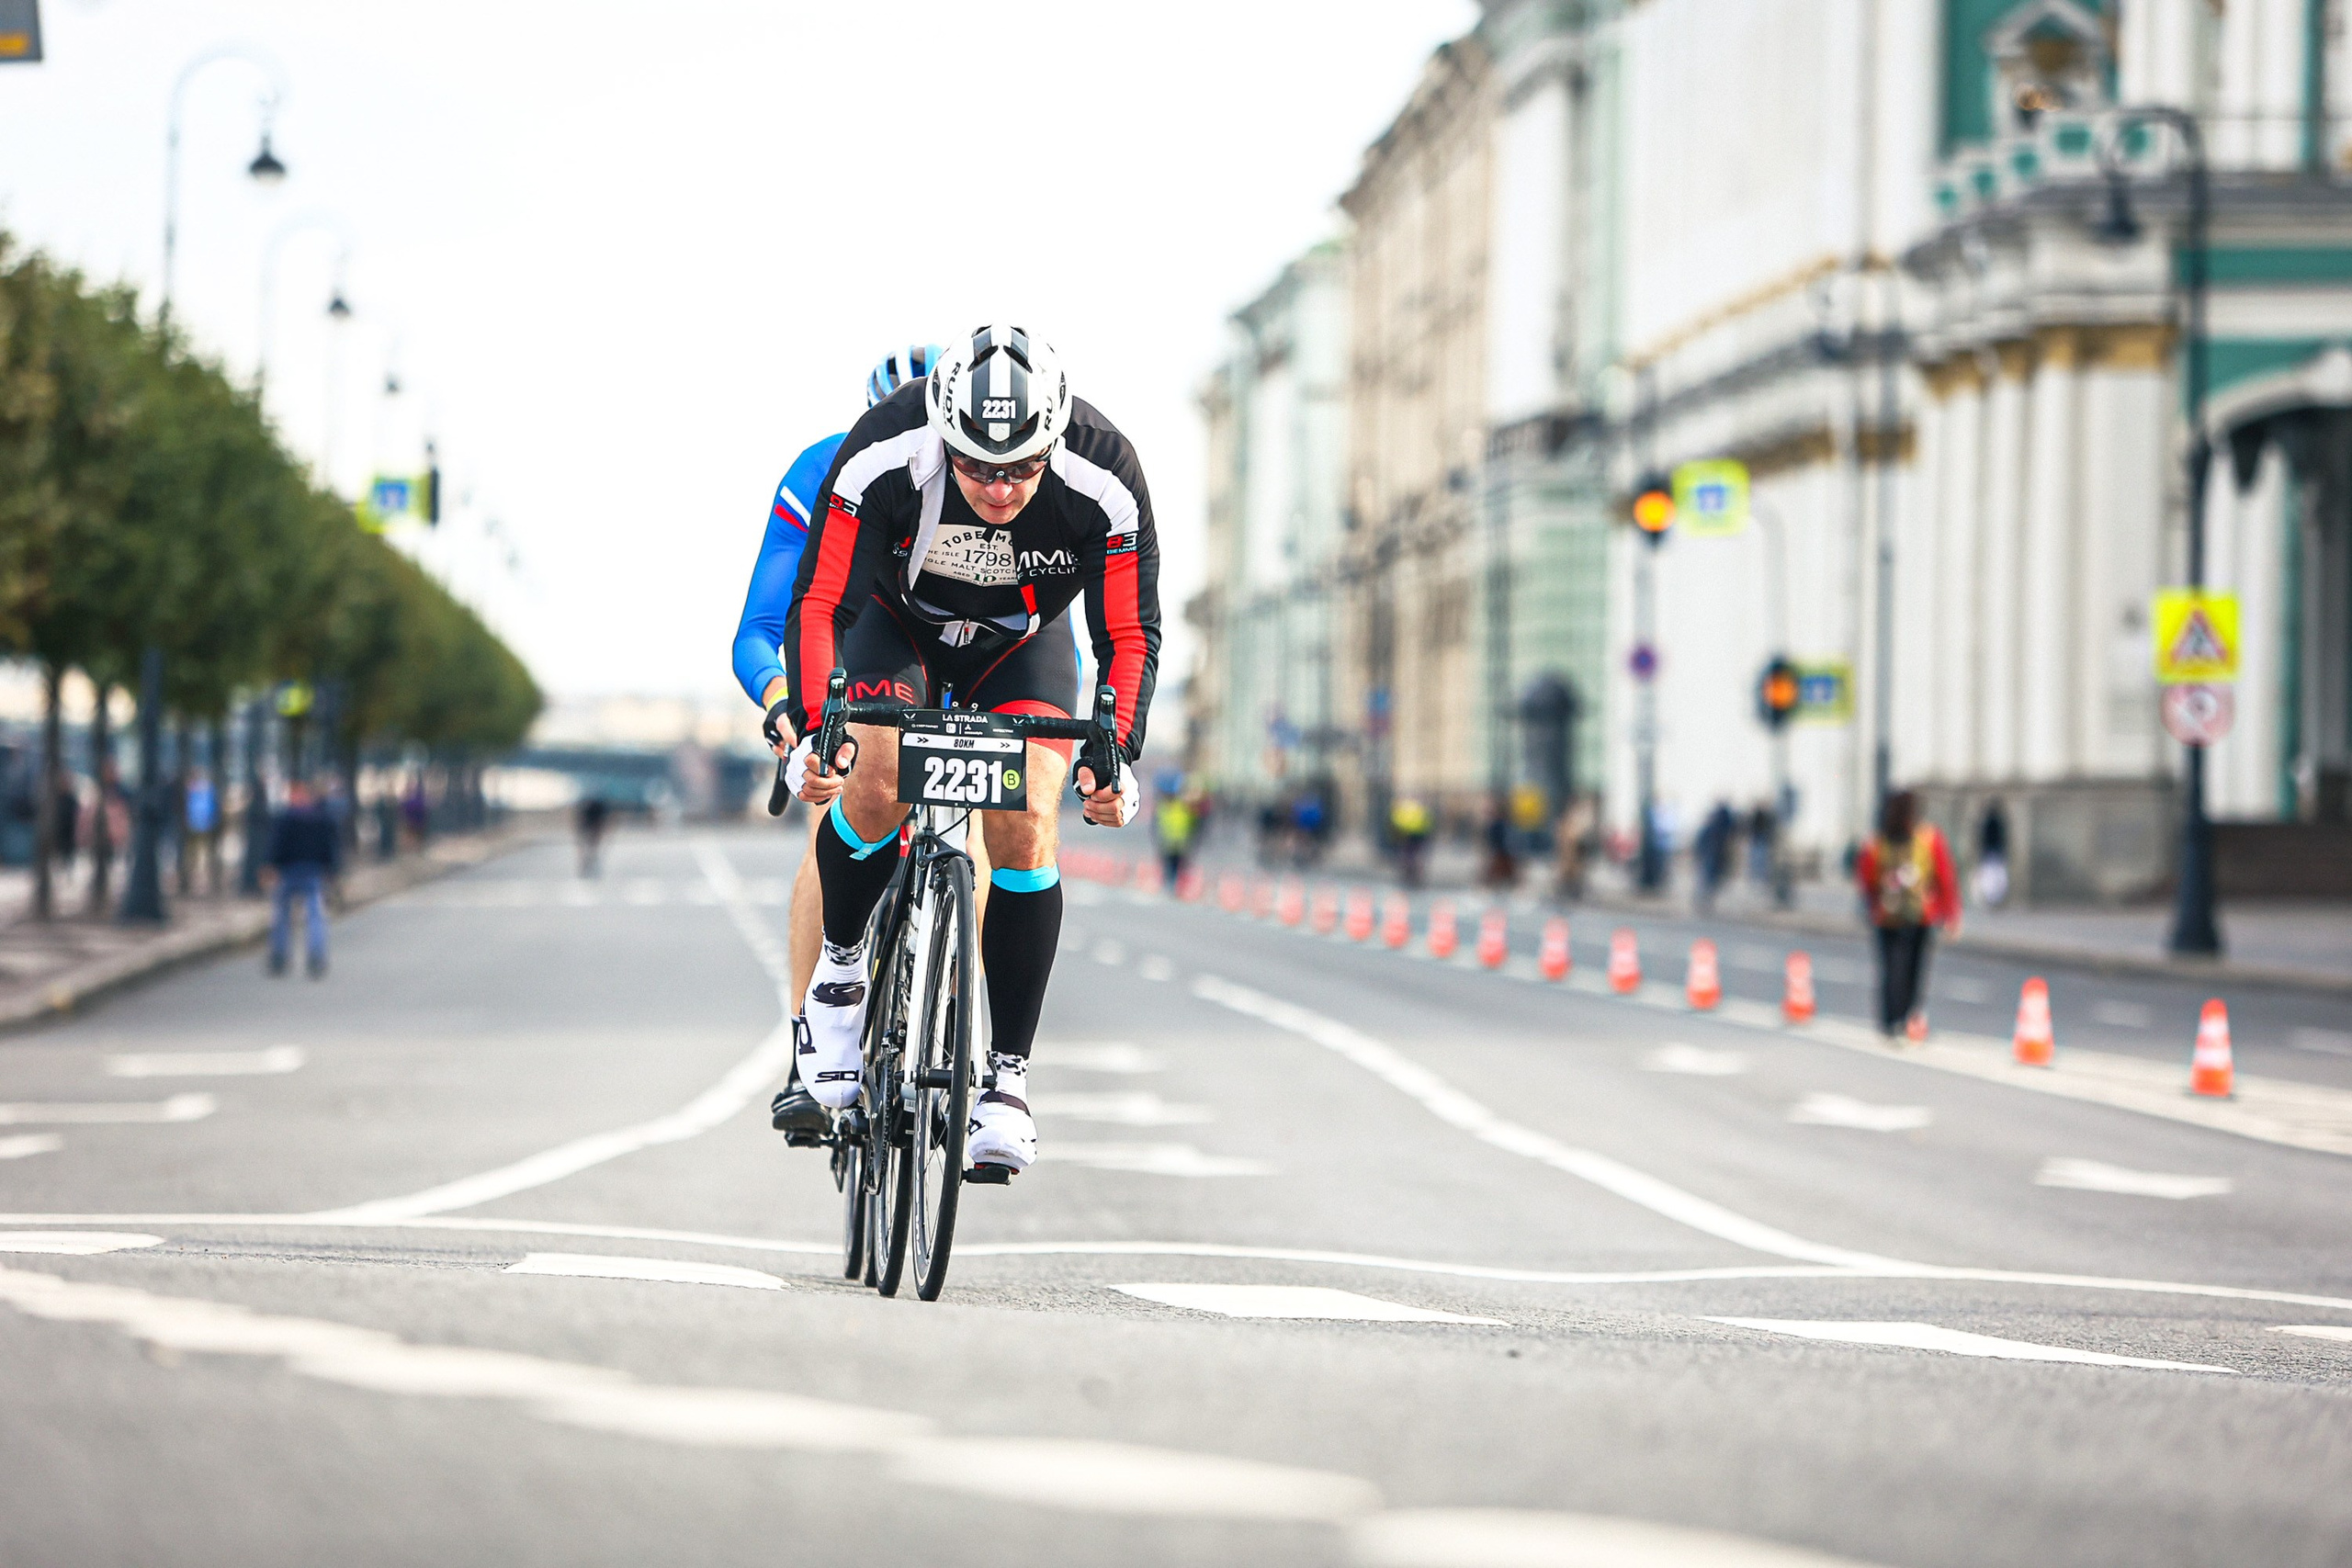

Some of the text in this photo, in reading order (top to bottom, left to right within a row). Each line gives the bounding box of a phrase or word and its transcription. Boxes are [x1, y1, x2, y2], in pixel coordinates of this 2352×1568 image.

[944, 361, 961, 430] RUDY
[981, 400, 1016, 419] 2231
[942, 531, 983, 548] TOBE
[951, 562, 976, 571] MALT
[963, 549, 1012, 567] 1798
[973, 572, 997, 583] 10
[847, 680, 915, 705] ME
[943, 714, 988, 724] LA STRADA
[954, 739, 975, 749] 80KM
[922, 756, 1002, 804] 2231
[1007, 773, 1016, 785] B
